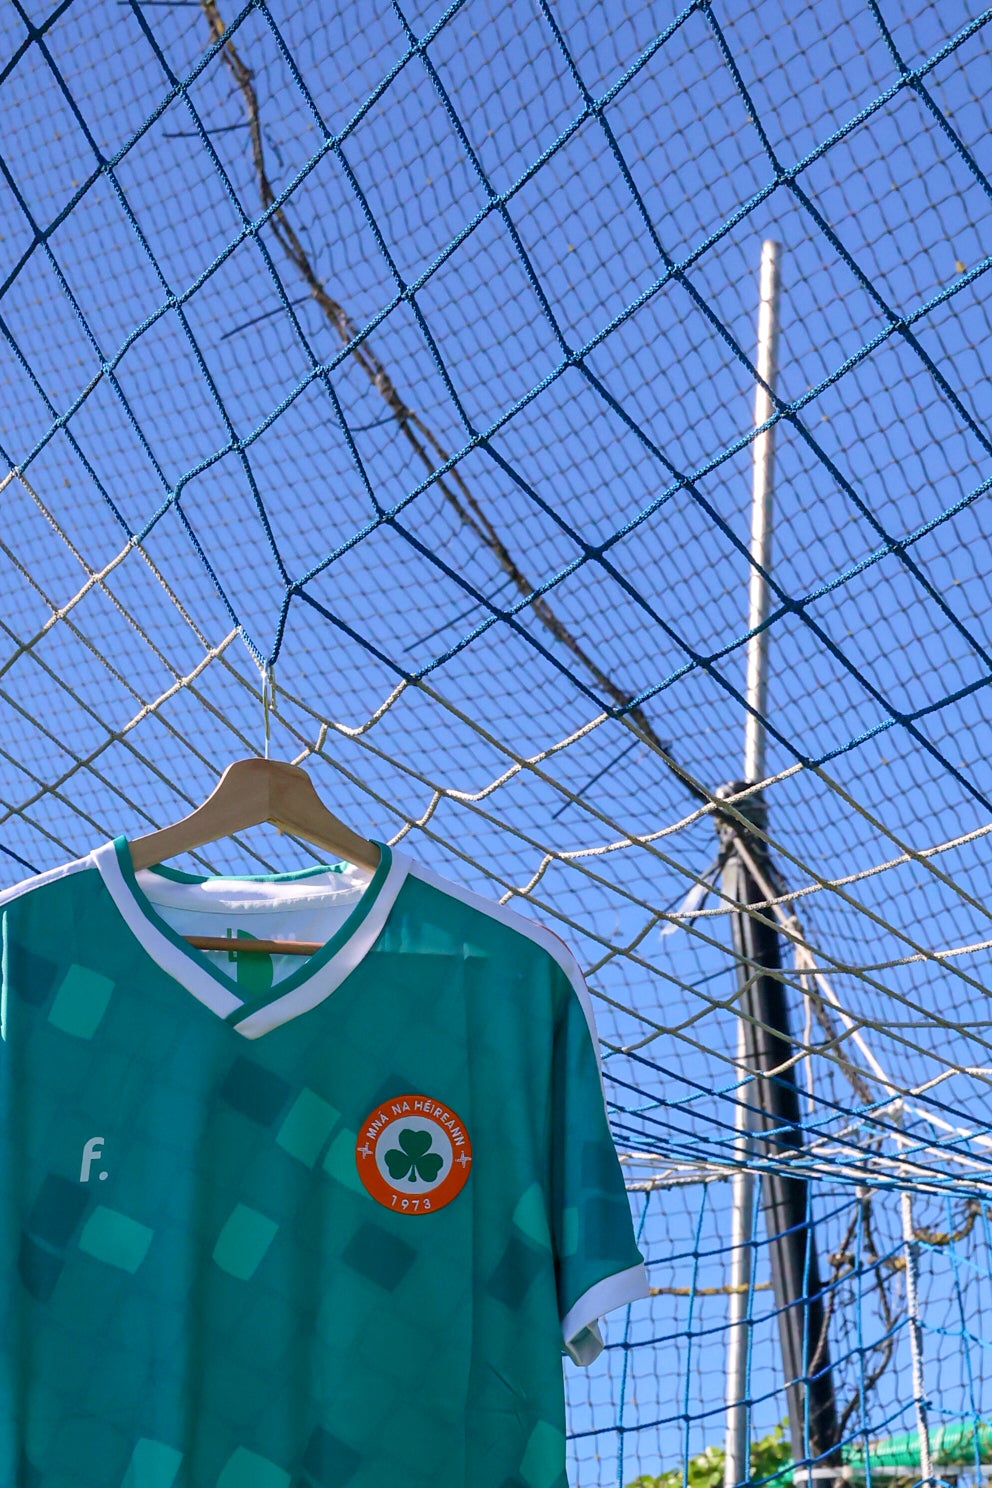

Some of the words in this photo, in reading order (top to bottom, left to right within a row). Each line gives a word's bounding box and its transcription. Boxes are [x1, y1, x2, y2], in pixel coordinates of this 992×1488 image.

[366, 1110, 389, 1140] MNÁ
[391, 1101, 410, 1116] NA
[414, 1100, 466, 1146] HÉIREANN
[391, 1194, 432, 1211] 1973
